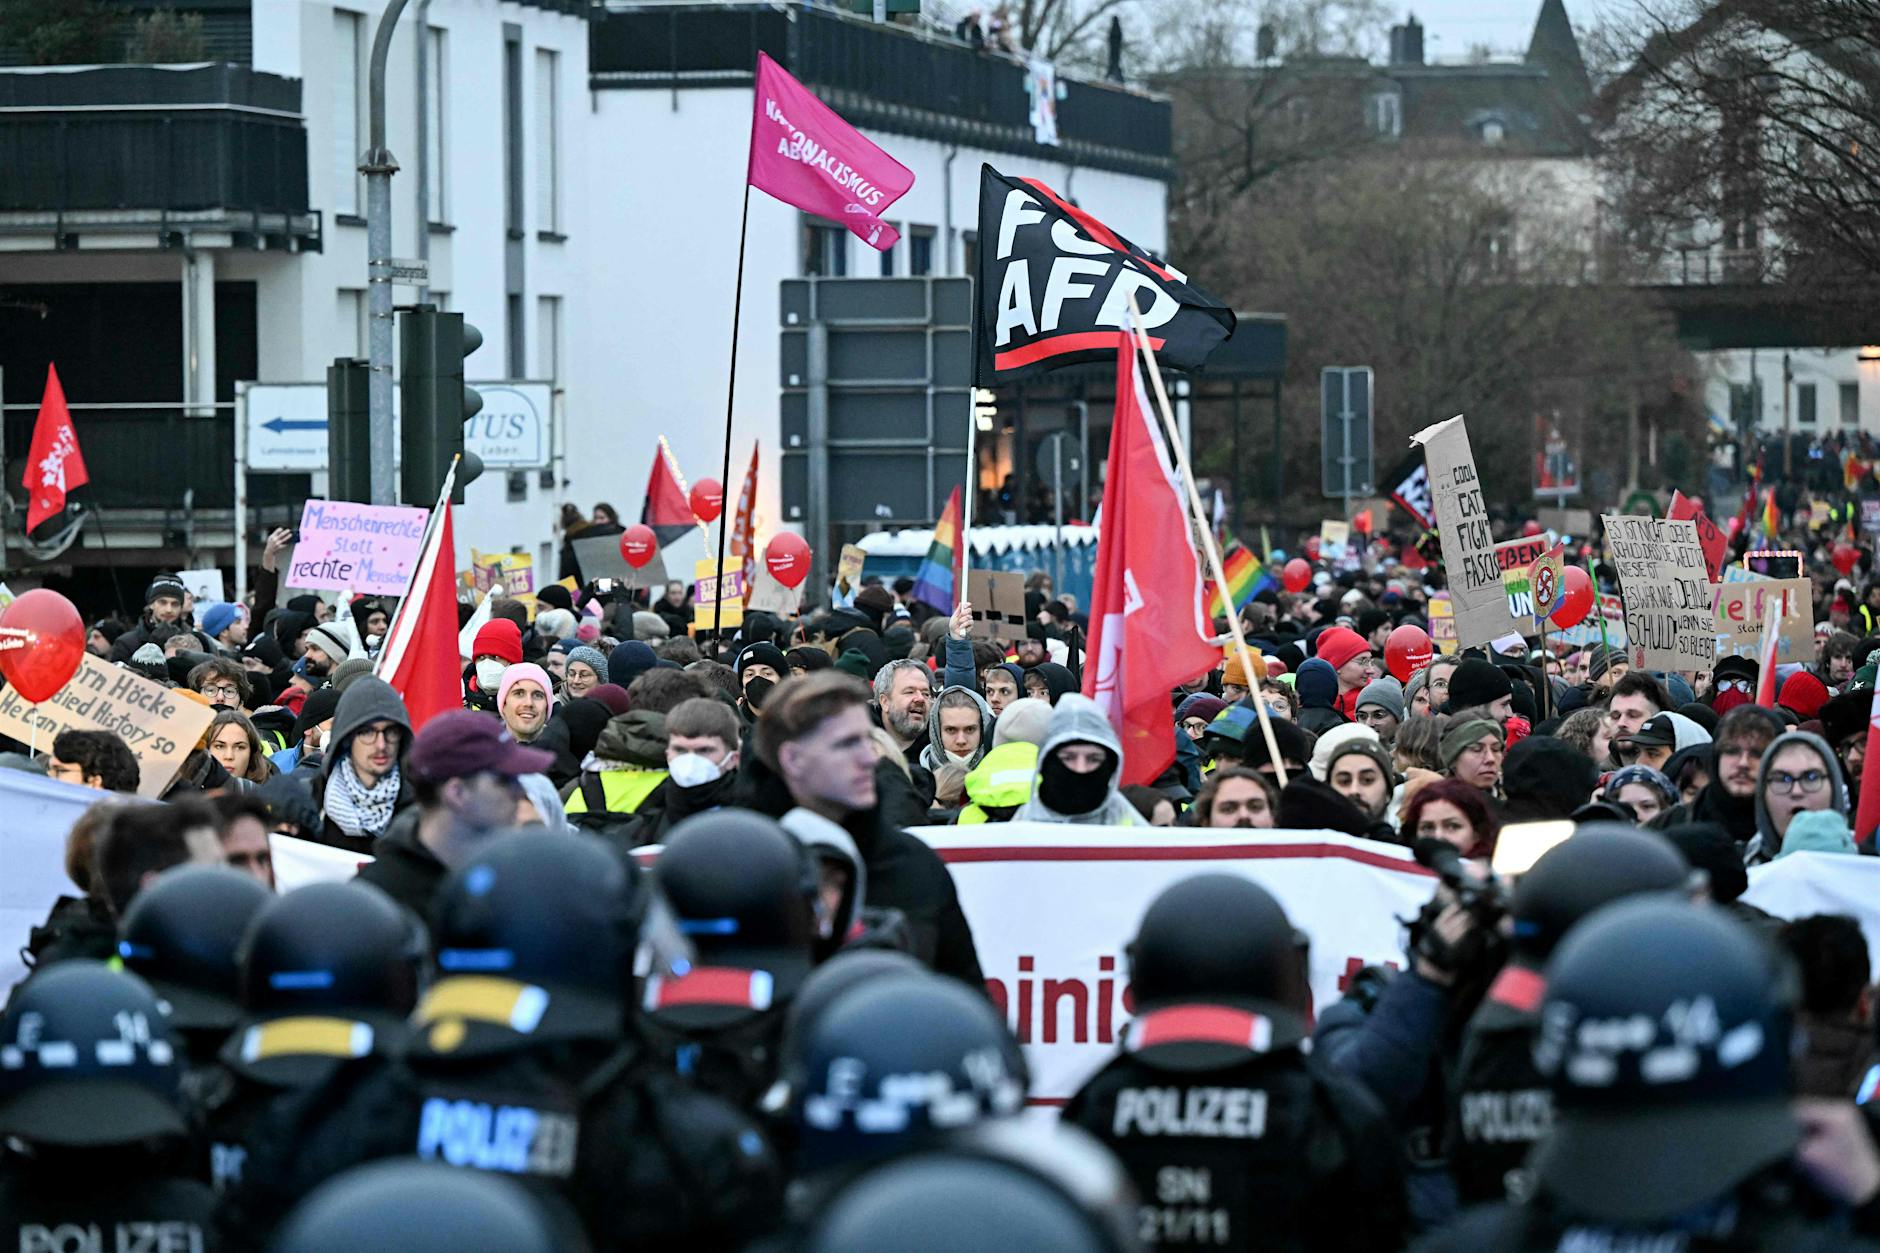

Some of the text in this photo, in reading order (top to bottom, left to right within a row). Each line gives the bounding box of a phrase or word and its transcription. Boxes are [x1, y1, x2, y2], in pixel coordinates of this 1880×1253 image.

[995, 256, 1181, 347] AFD
[1453, 464, 1476, 486] COOL
[304, 505, 421, 539] Menschenrechte
[292, 558, 353, 581] rechte
[1, 691, 22, 719] He
[108, 674, 176, 719] Höcke
[92, 697, 153, 745] History
[150, 736, 176, 755] so
[1113, 1086, 1269, 1139] POLIZEI
[1157, 1166, 1212, 1203] SN
